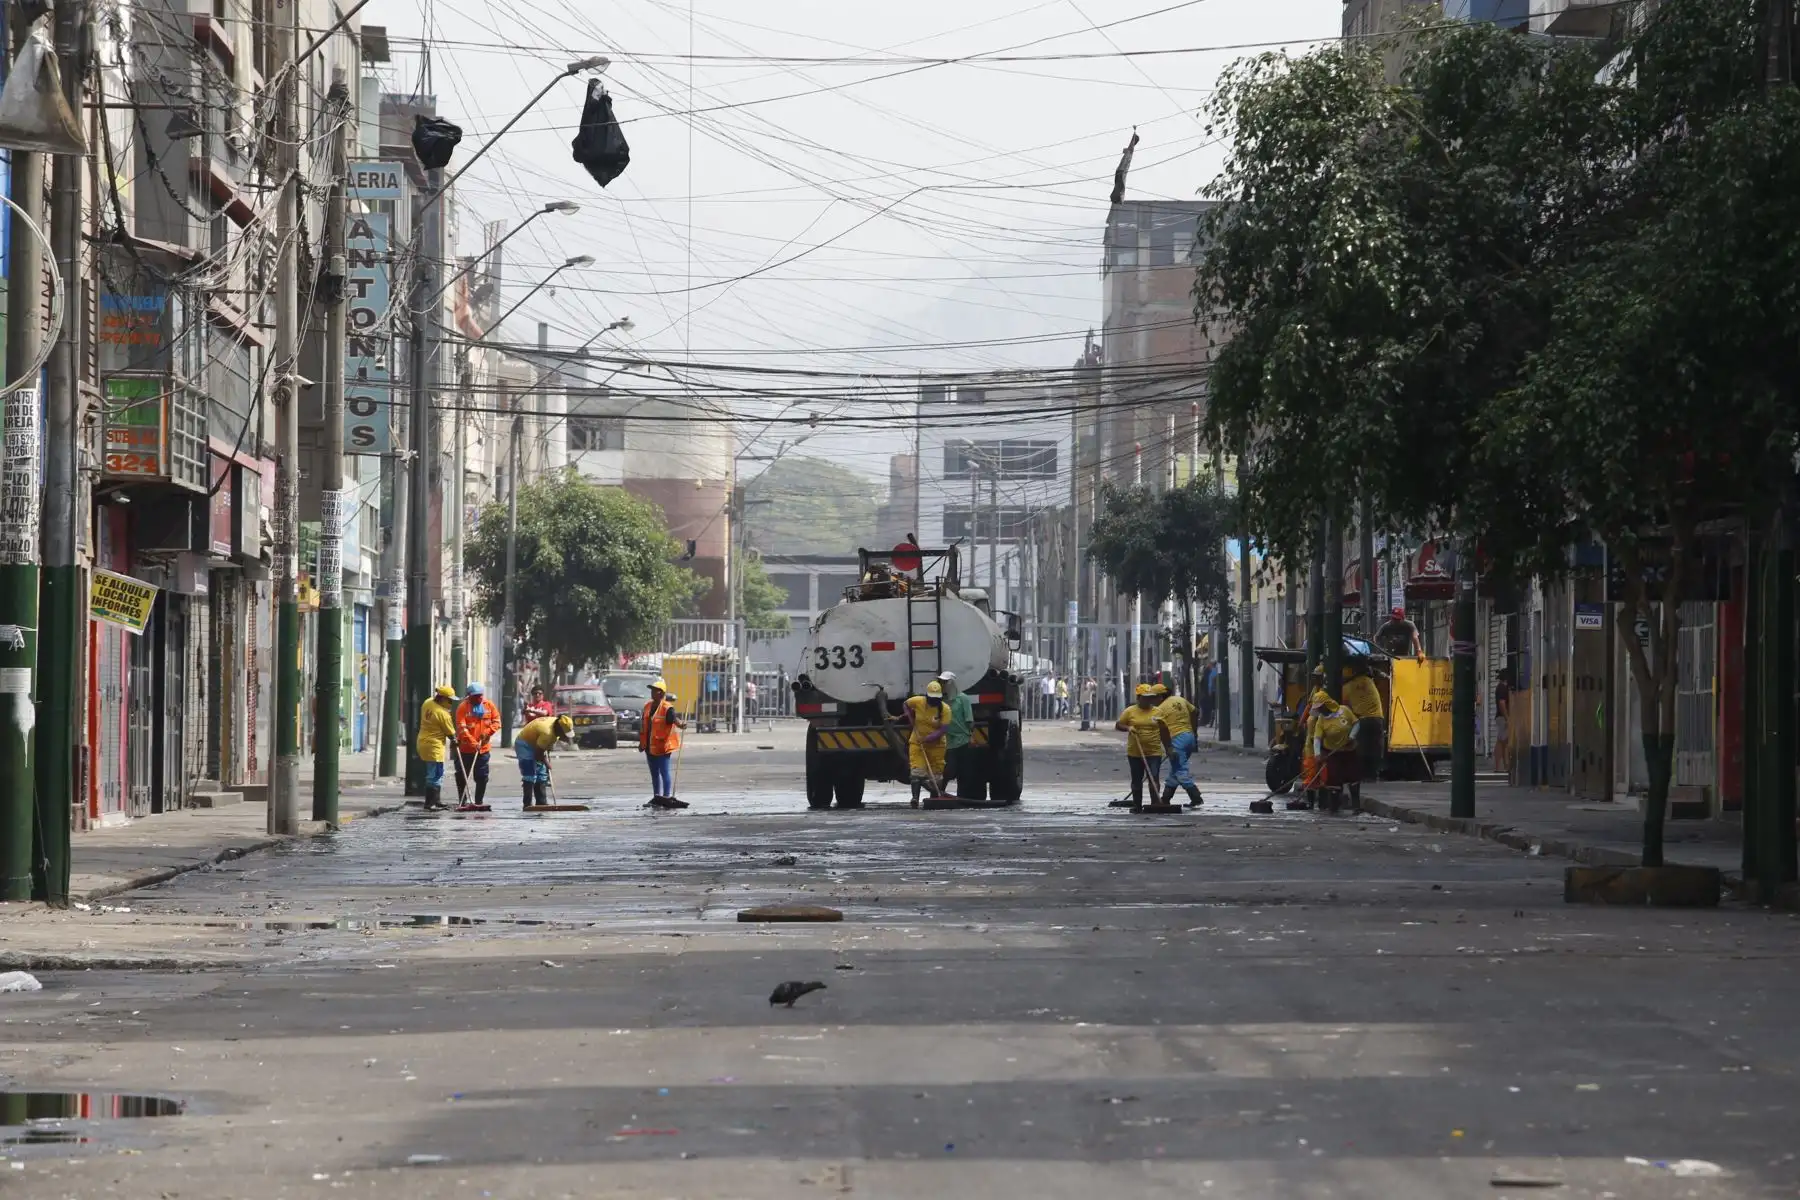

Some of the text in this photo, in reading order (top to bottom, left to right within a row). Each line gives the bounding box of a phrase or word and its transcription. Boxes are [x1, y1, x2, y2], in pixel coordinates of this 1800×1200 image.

[106, 453, 157, 473] 324
[95, 575, 151, 600] SE ALQUILA
[98, 586, 141, 608] LOCALES
[91, 595, 142, 619] INFORMES
[1580, 616, 1599, 625] VISA
[814, 644, 865, 670] 333
[1422, 699, 1433, 712] La
